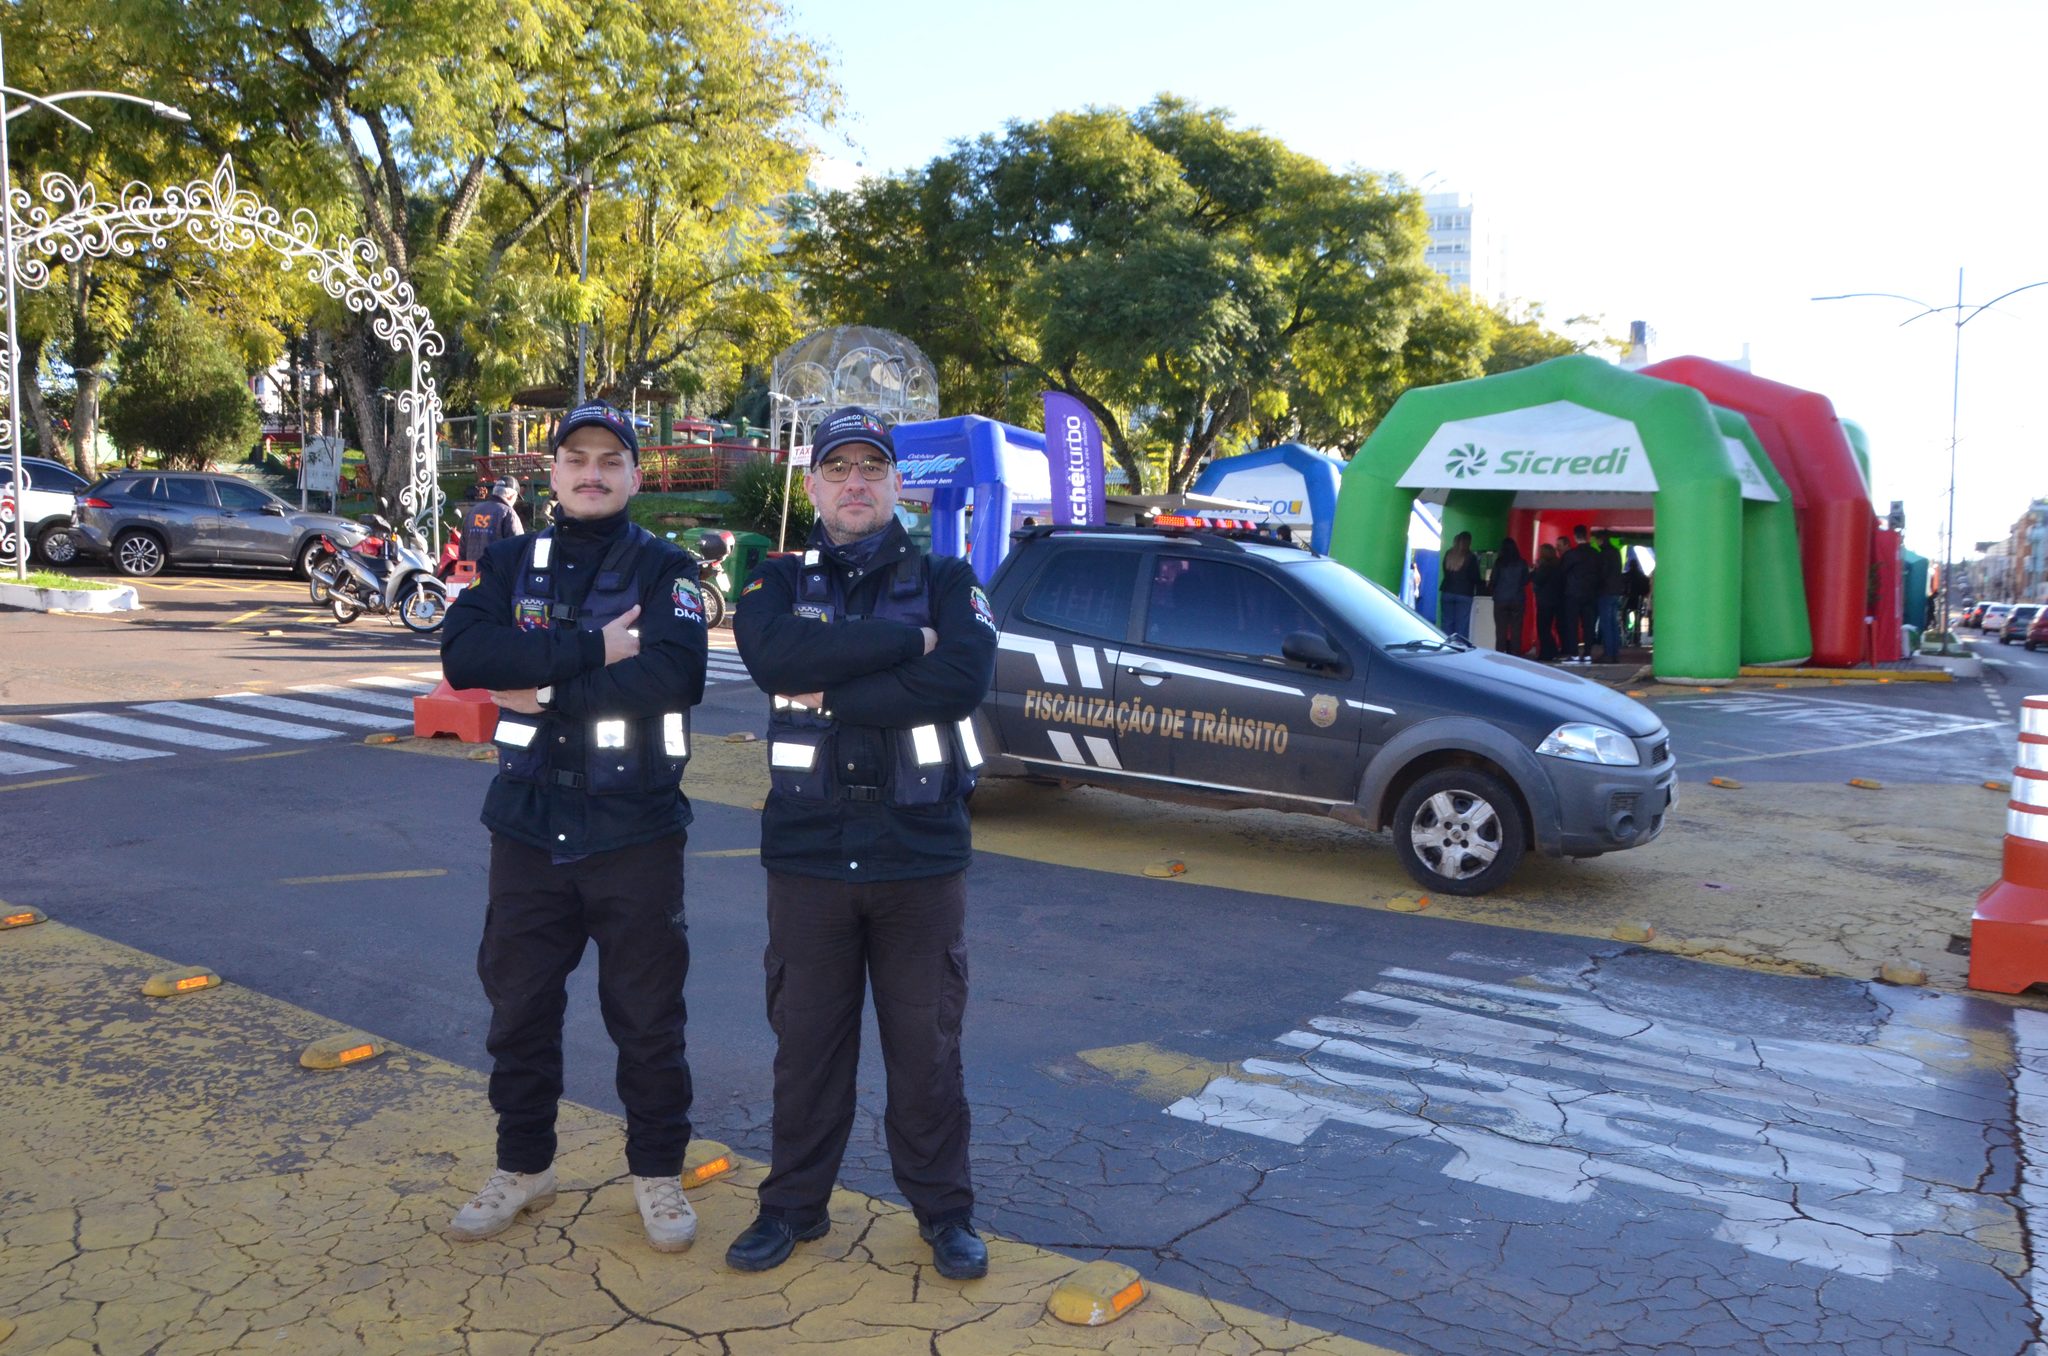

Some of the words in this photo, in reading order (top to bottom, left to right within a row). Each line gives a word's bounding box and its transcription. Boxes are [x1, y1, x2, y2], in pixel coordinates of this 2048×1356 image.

[830, 414, 860, 427] FREDERICO
[795, 446, 813, 457] TAX
[1493, 446, 1631, 475] Sicredi
[1065, 416, 1087, 526] tchêturbo
[674, 607, 702, 623] DMT
[1024, 689, 1156, 738] FISCALIZAÇÃO
[1160, 707, 1186, 739] DE
[1192, 708, 1289, 755] TRÂNSITO
